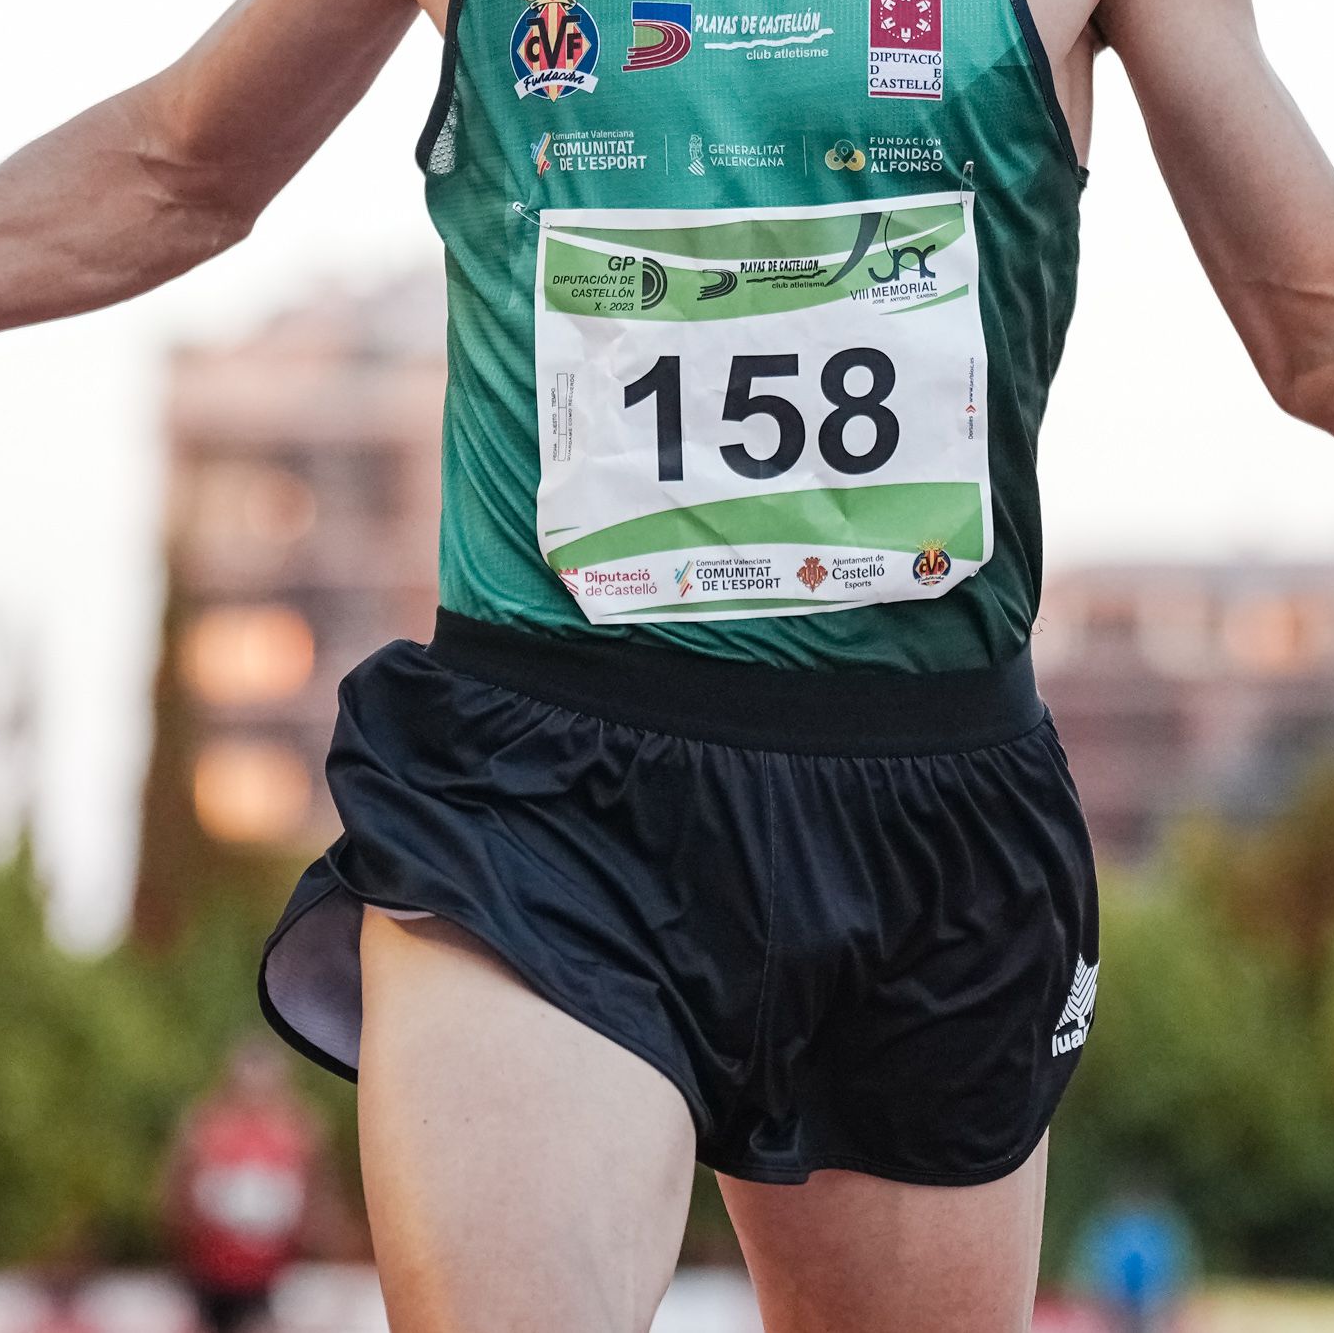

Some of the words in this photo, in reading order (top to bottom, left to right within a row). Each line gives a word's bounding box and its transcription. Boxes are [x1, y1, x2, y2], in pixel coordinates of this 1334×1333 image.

[695, 14, 738, 34] PLAYAS
[741, 15, 756, 34] DE
[759, 7, 821, 34] CASTELLÓN
[746, 50, 771, 61] club
[774, 47, 829, 59] atletisme
[870, 52, 942, 66] DIPUTACIÓ
[523, 70, 585, 91] Fundación
[870, 78, 941, 91] CASTELLÓ
[551, 131, 589, 141] Comunitat
[590, 130, 635, 139] Valenciana
[870, 137, 941, 147] FUNDACIÓN
[553, 140, 635, 157] COMUNITAT
[708, 144, 785, 156] GENERALITAT
[869, 147, 943, 161] TRINIDAD
[560, 157, 574, 171] DE
[578, 155, 647, 171] L'ESPORT
[710, 156, 785, 168] VALENCIANA
[870, 161, 943, 174] ALFONSO
[608, 256, 636, 272] GP
[740, 260, 766, 274] PLAYAS
[768, 260, 778, 272] DE
[552, 274, 617, 285] DIPUTACIÓN
[620, 275, 635, 285] DE
[771, 281, 788, 289] club
[571, 287, 635, 298] CASTELLÓN
[850, 288, 869, 301] VIII
[871, 281, 937, 298] MEMORIAL
[610, 302, 634, 311] 2023
[624, 347, 900, 482] 158
[696, 559, 732, 567] Comunitat
[733, 558, 771, 566] Valenciana
[832, 556, 873, 567] Ajuntament
[875, 554, 884, 562] de
[584, 568, 650, 585] Diputació
[696, 566, 772, 579] COMUNITAT
[832, 564, 885, 580] Castelló
[585, 585, 602, 596] de
[604, 582, 658, 596] Castelló
[702, 580, 719, 591] DE
[722, 577, 781, 590] L'ESPORT
[844, 580, 872, 590] Esports
